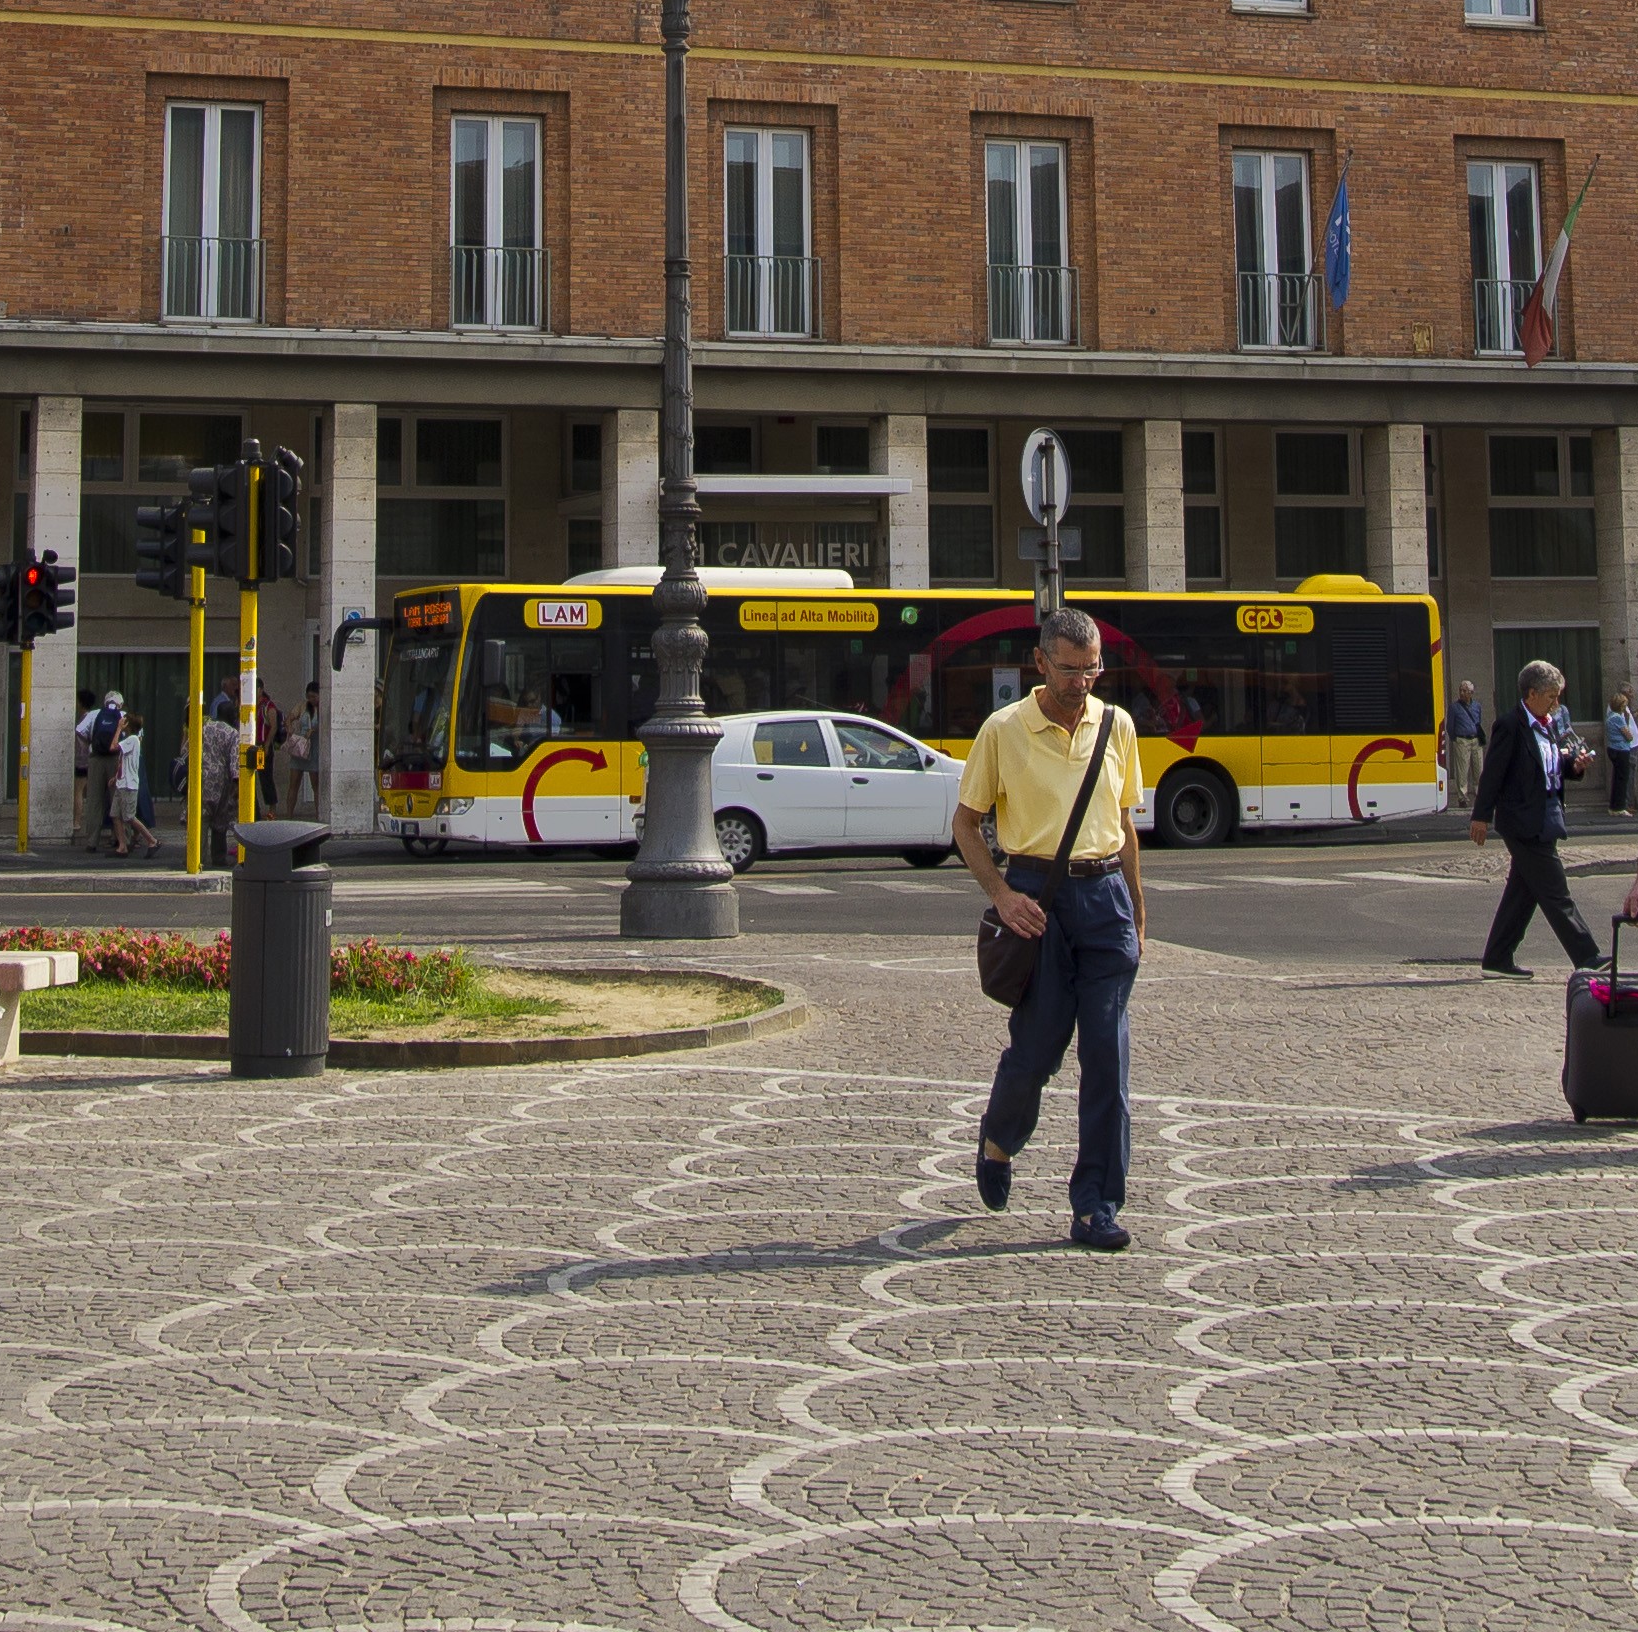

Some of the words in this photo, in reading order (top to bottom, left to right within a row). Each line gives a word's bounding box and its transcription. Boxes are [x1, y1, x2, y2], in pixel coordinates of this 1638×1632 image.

[717, 542, 869, 567] CAVALIERI
[542, 605, 584, 623] LAM
[743, 608, 777, 622] Linea
[781, 609, 796, 623] ad
[800, 609, 824, 623] Alta
[827, 609, 876, 624] Mobilità
[1244, 608, 1281, 633] cpt
